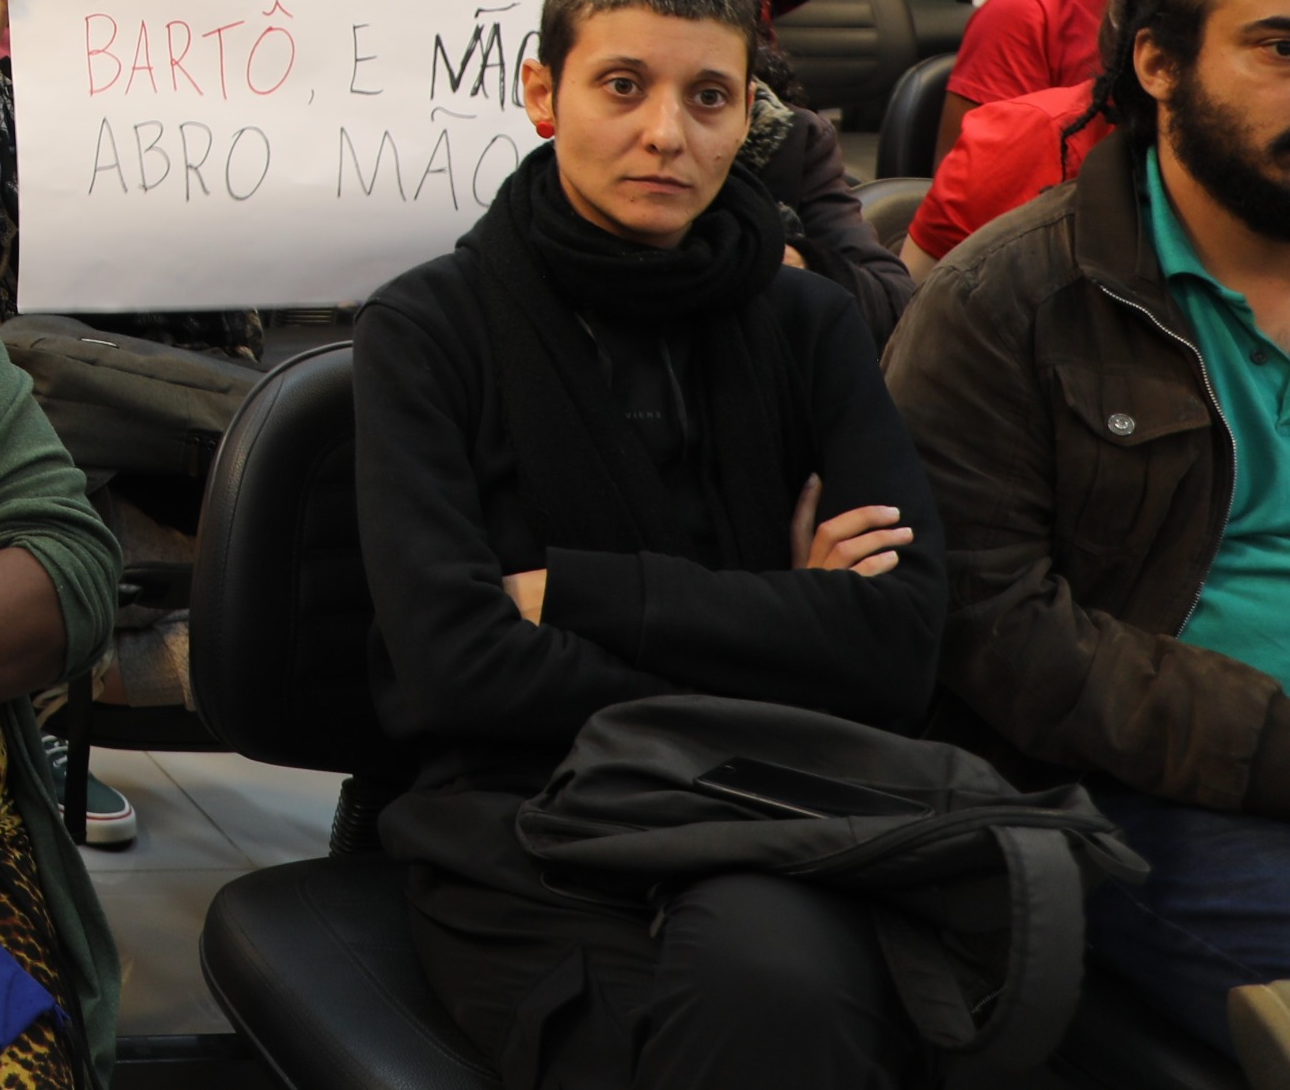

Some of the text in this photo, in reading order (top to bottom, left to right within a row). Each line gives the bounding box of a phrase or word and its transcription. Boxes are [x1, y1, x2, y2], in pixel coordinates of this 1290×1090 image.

[84, 0, 316, 105] BARTÔ,
[349, 23, 385, 96] E
[89, 106, 520, 212] ABRO MÃO
